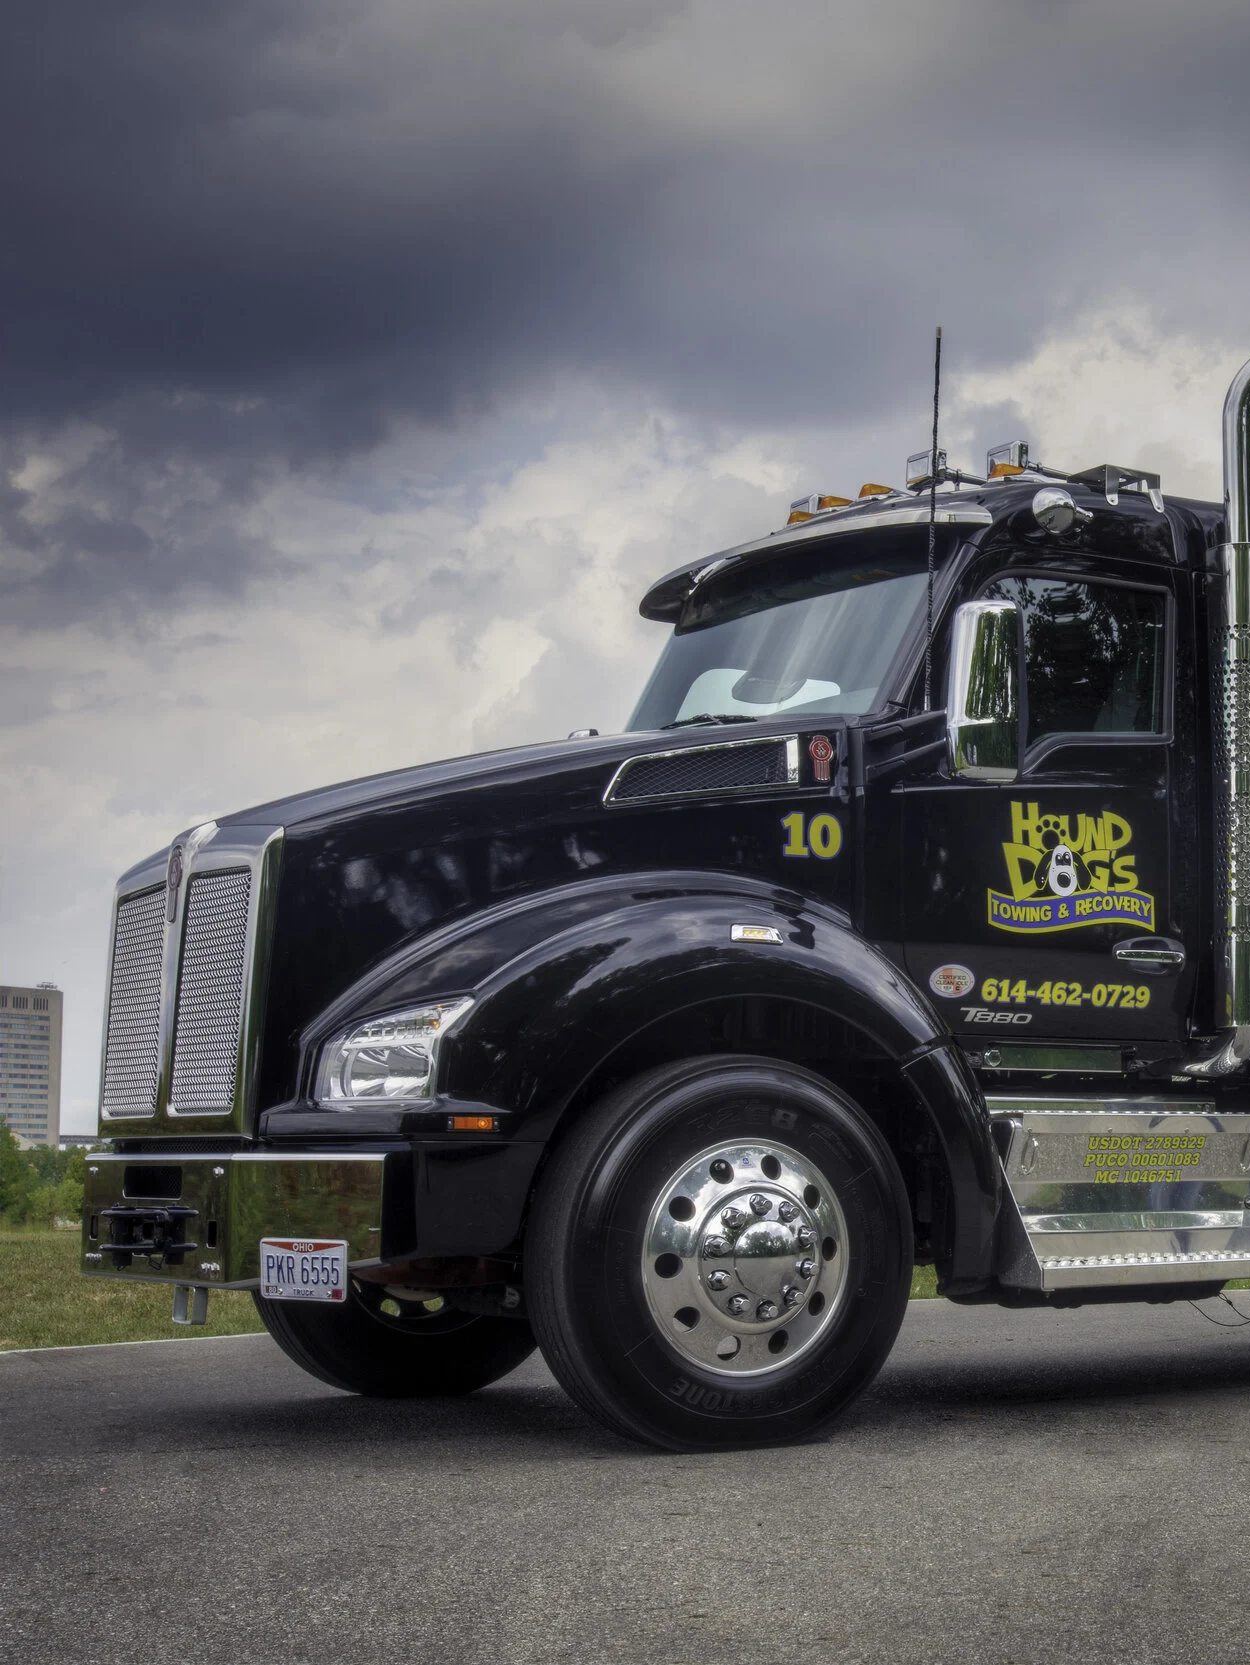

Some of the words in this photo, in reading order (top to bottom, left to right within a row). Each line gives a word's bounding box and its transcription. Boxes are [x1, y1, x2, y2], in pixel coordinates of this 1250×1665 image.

[780, 811, 843, 860] 10
[1010, 800, 1133, 853] HOUND
[991, 899, 1052, 923] TOWING
[1057, 902, 1070, 919] &
[1075, 895, 1152, 917] RECOVERY
[981, 977, 1151, 1009] 614-462-0729
[960, 1006, 1033, 1024] T880
[1088, 1136, 1143, 1150] USDOT
[1144, 1135, 1206, 1150] 2789329
[1083, 1153, 1129, 1167] PUCO
[1131, 1152, 1201, 1166] 00601083
[1094, 1170, 1120, 1184] MC
[1123, 1169, 1183, 1183] 1046751
[292, 1242, 314, 1252] OHIO
[266, 1254, 296, 1284] PKR
[301, 1255, 340, 1286] 6555
[293, 1288, 315, 1296] TRUCK
